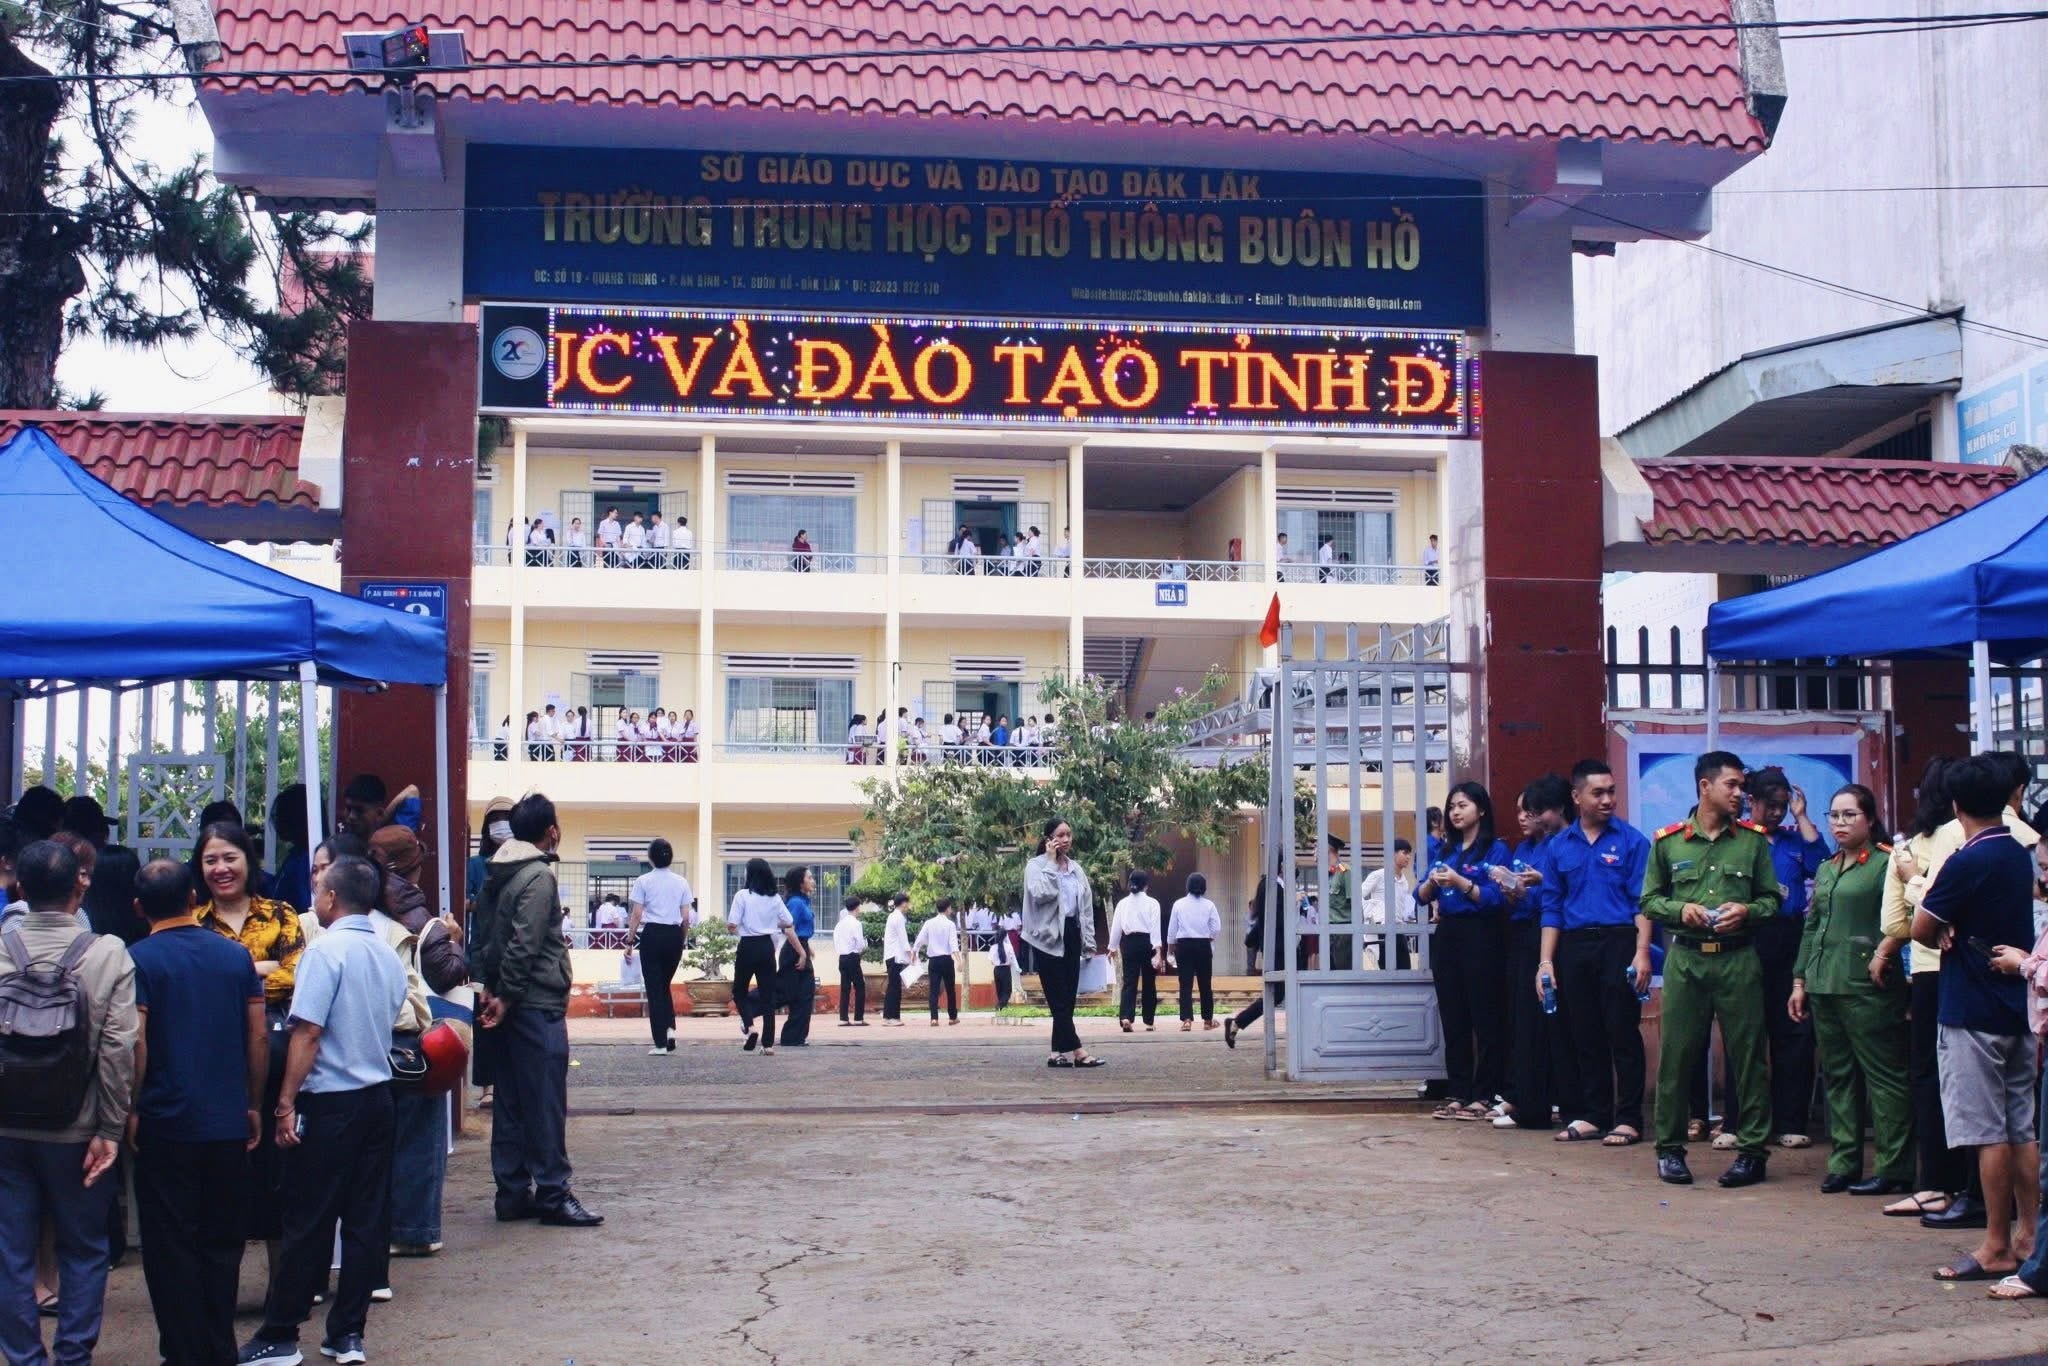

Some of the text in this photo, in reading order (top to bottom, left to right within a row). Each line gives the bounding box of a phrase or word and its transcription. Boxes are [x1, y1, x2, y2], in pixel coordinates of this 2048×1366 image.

[758, 154, 832, 186] GIÁO
[847, 160, 911, 193] DỤC
[924, 160, 964, 191] VÀ
[977, 161, 1040, 193] ĐÀO
[538, 187, 1421, 271] TRƯỜNG TRUNG HỌC PHỔ THÔNG BUÔN HỒ
[592, 272, 624, 285] QUANG
[627, 272, 657, 286] TRUNG
[1255, 293, 1283, 305] Email:
[652, 319, 773, 397] VÀ
[795, 324, 974, 403] ĐÀO
[994, 345, 1159, 419] TẠO
[1159, 585, 1184, 601] NHÀ B
